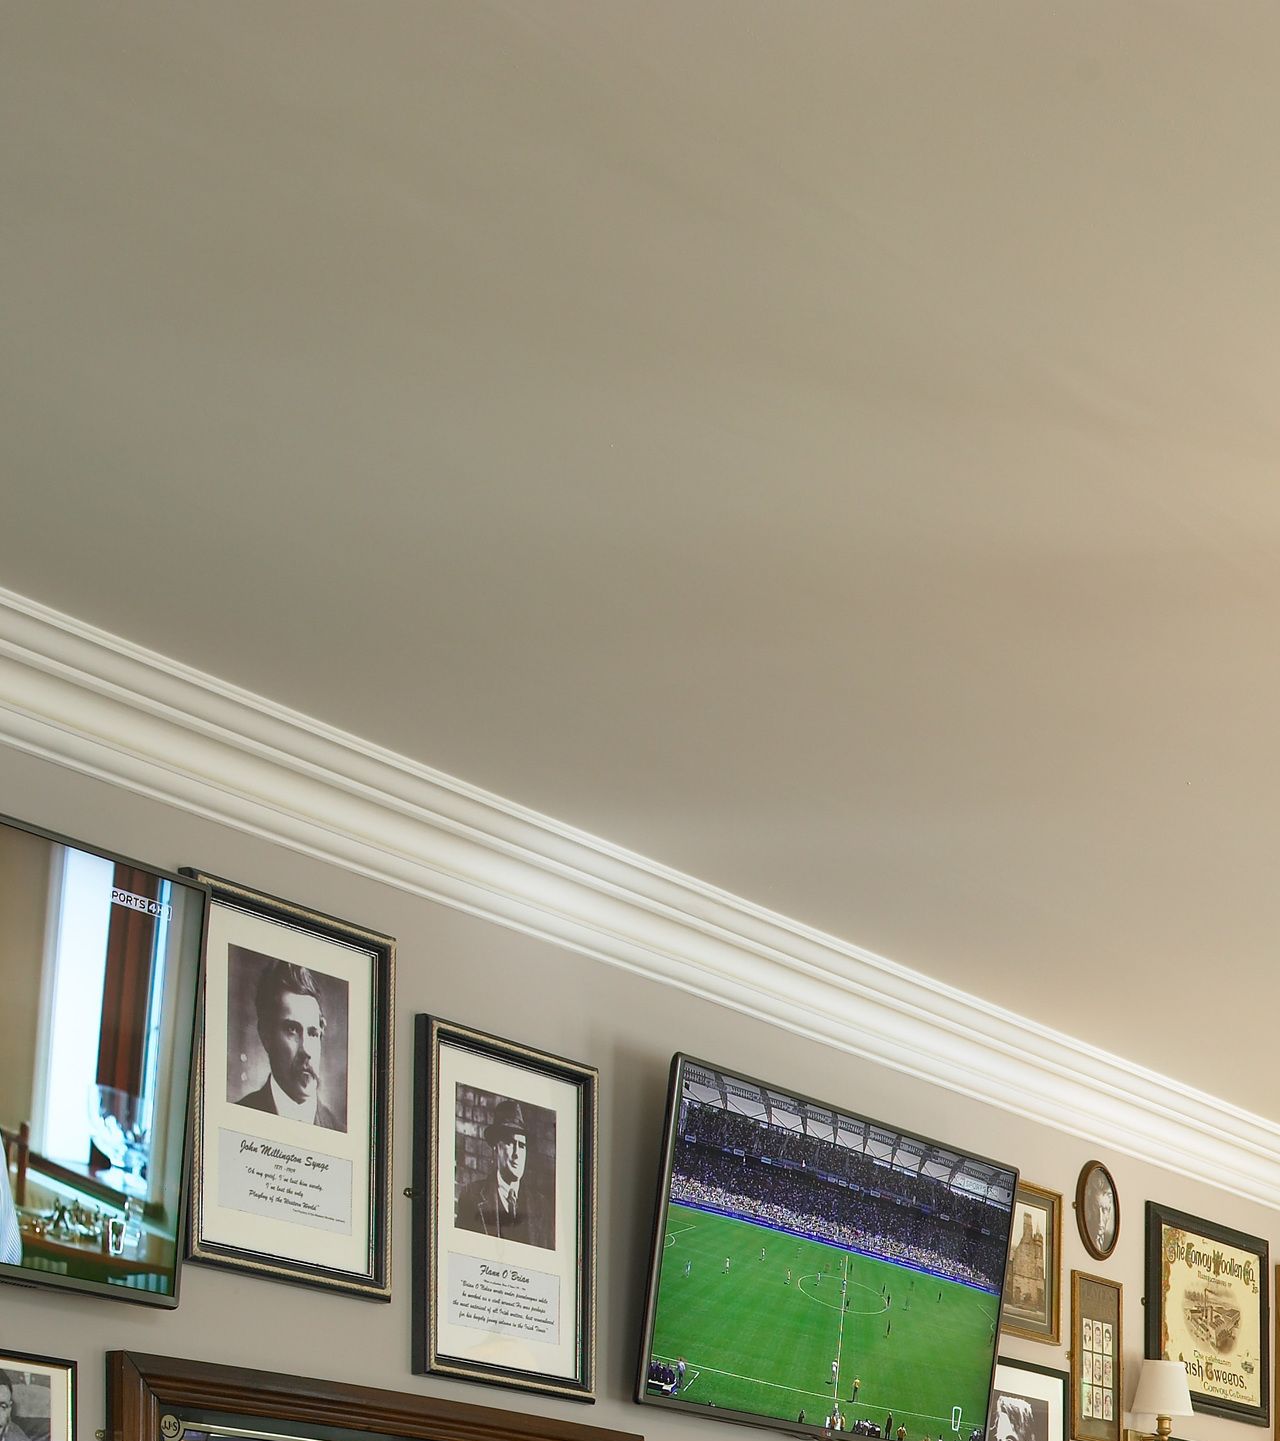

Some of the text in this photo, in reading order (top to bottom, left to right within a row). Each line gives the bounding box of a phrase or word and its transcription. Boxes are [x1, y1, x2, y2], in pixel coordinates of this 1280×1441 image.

[240, 1139, 258, 1153] John
[260, 1144, 302, 1165] Millington
[304, 1156, 329, 1173] Synge
[479, 1264, 530, 1284] Flann O'Brian
